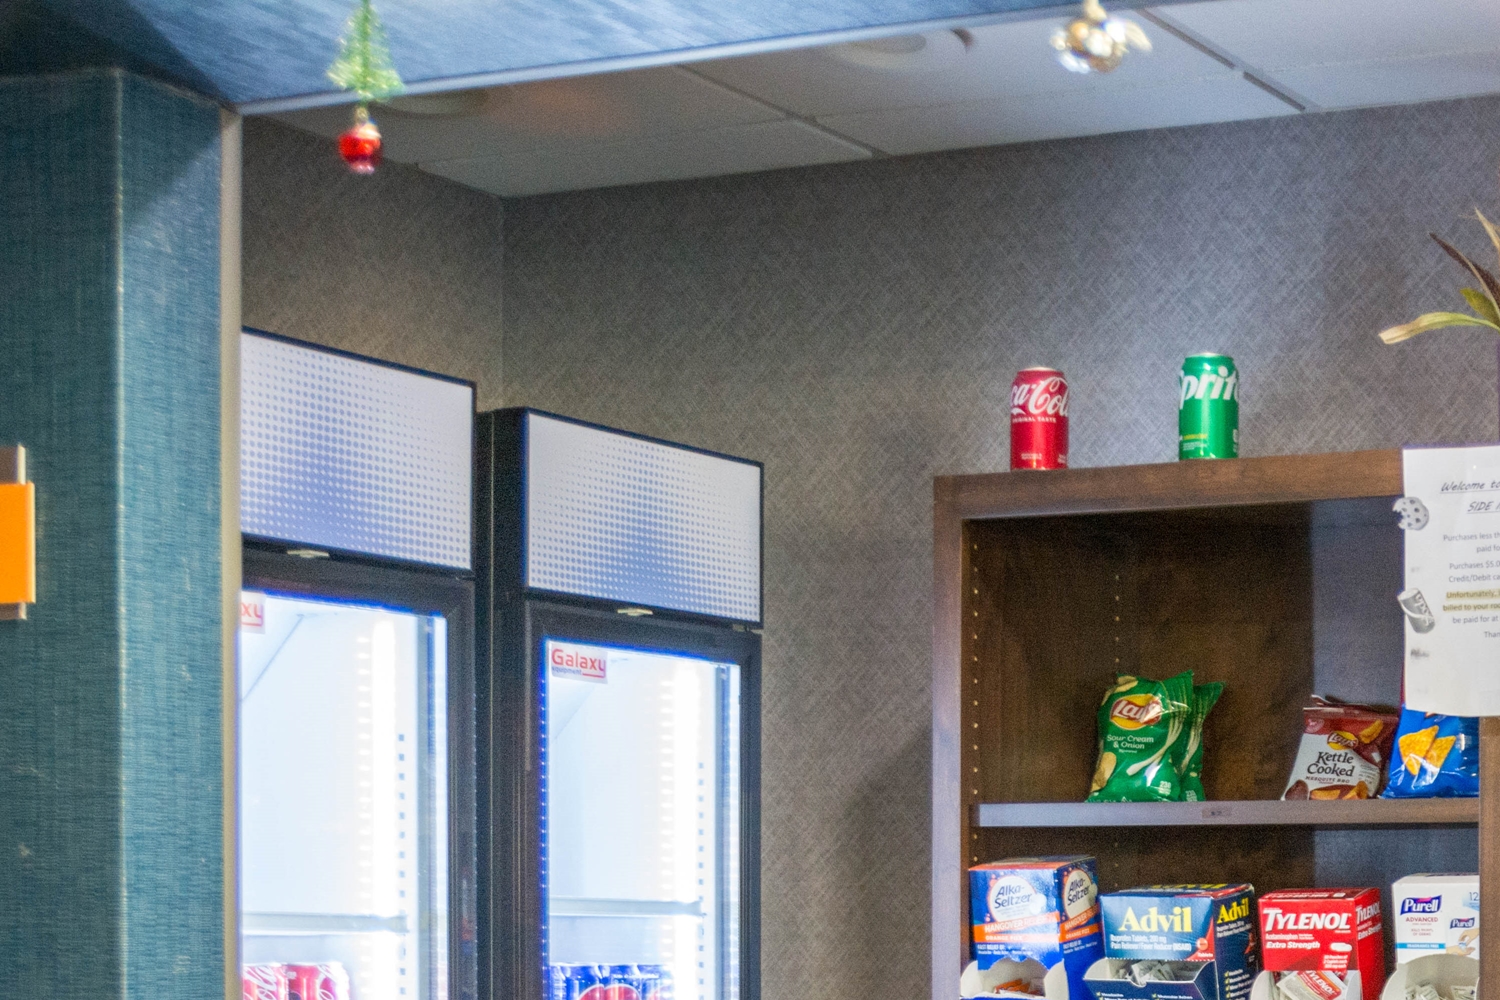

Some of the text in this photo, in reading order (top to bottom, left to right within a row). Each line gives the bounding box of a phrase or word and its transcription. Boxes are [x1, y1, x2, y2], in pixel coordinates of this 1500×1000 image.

[1441, 482, 1485, 492] Welcome
[1468, 501, 1494, 512] SIDE
[1450, 562, 1483, 570] Purchases
[1449, 575, 1491, 583] Credit/Debit
[1474, 603, 1489, 611] your
[1463, 616, 1478, 624] paid
[552, 649, 606, 676] Galaxy
[1128, 735, 1154, 743] Cream
[1317, 751, 1354, 764] Kettle
[1307, 764, 1355, 776] Cooked
[996, 885, 1024, 897] Alka-
[995, 894, 1032, 909] Seltzer
[1217, 898, 1250, 924] Advil
[1118, 906, 1192, 932] Advil
[1263, 909, 1351, 932] TYLENOL
